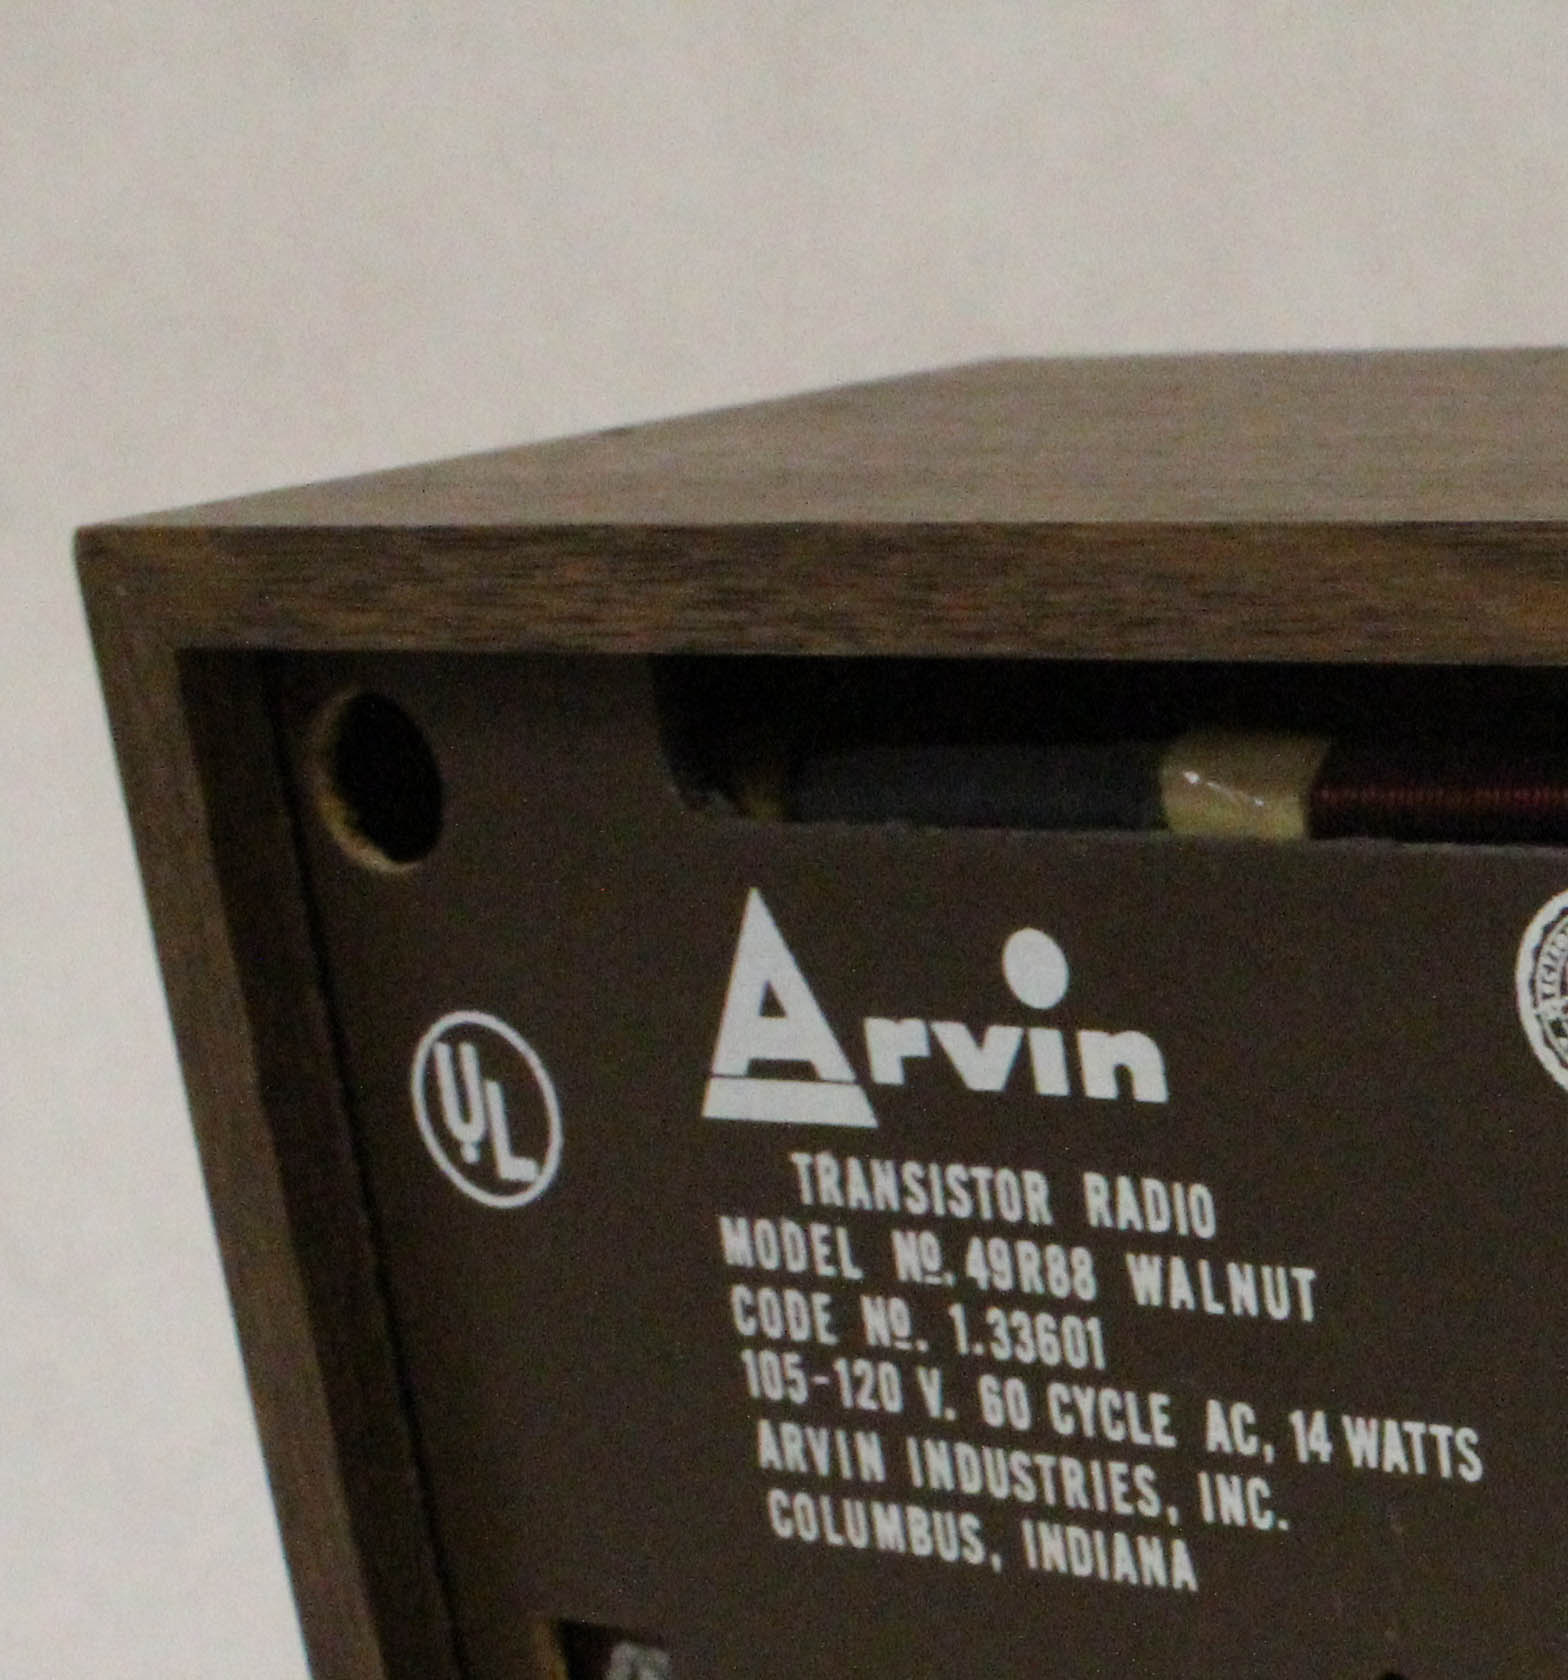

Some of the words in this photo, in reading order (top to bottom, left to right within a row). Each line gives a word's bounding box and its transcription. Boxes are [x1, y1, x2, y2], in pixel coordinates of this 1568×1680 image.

[702, 886, 1167, 1128] Arvin
[791, 1151, 1053, 1225] TRANSISTOR
[1083, 1172, 1217, 1239] RADIO
[719, 1216, 863, 1281] MODEL
[965, 1236, 1098, 1302] 49R88
[1126, 1253, 1316, 1322] WALNUT
[730, 1286, 838, 1345] CODE
[948, 1304, 1106, 1371] 1.33601
[741, 1349, 901, 1413] 105-120
[918, 1366, 955, 1421] V.
[978, 1377, 1030, 1432] 60
[1046, 1383, 1176, 1448] CYCLE
[1205, 1399, 1276, 1464] AC,
[1288, 1410, 1332, 1462] 14
[1341, 1414, 1484, 1483] WATTS
[757, 1419, 885, 1484] ARVIN
[907, 1436, 1179, 1525] INDUSTRIES,
[1199, 1473, 1290, 1532] INC.
[766, 1487, 1001, 1573] COLUMBUS,
[1021, 1519, 1199, 1592] INDIANA
